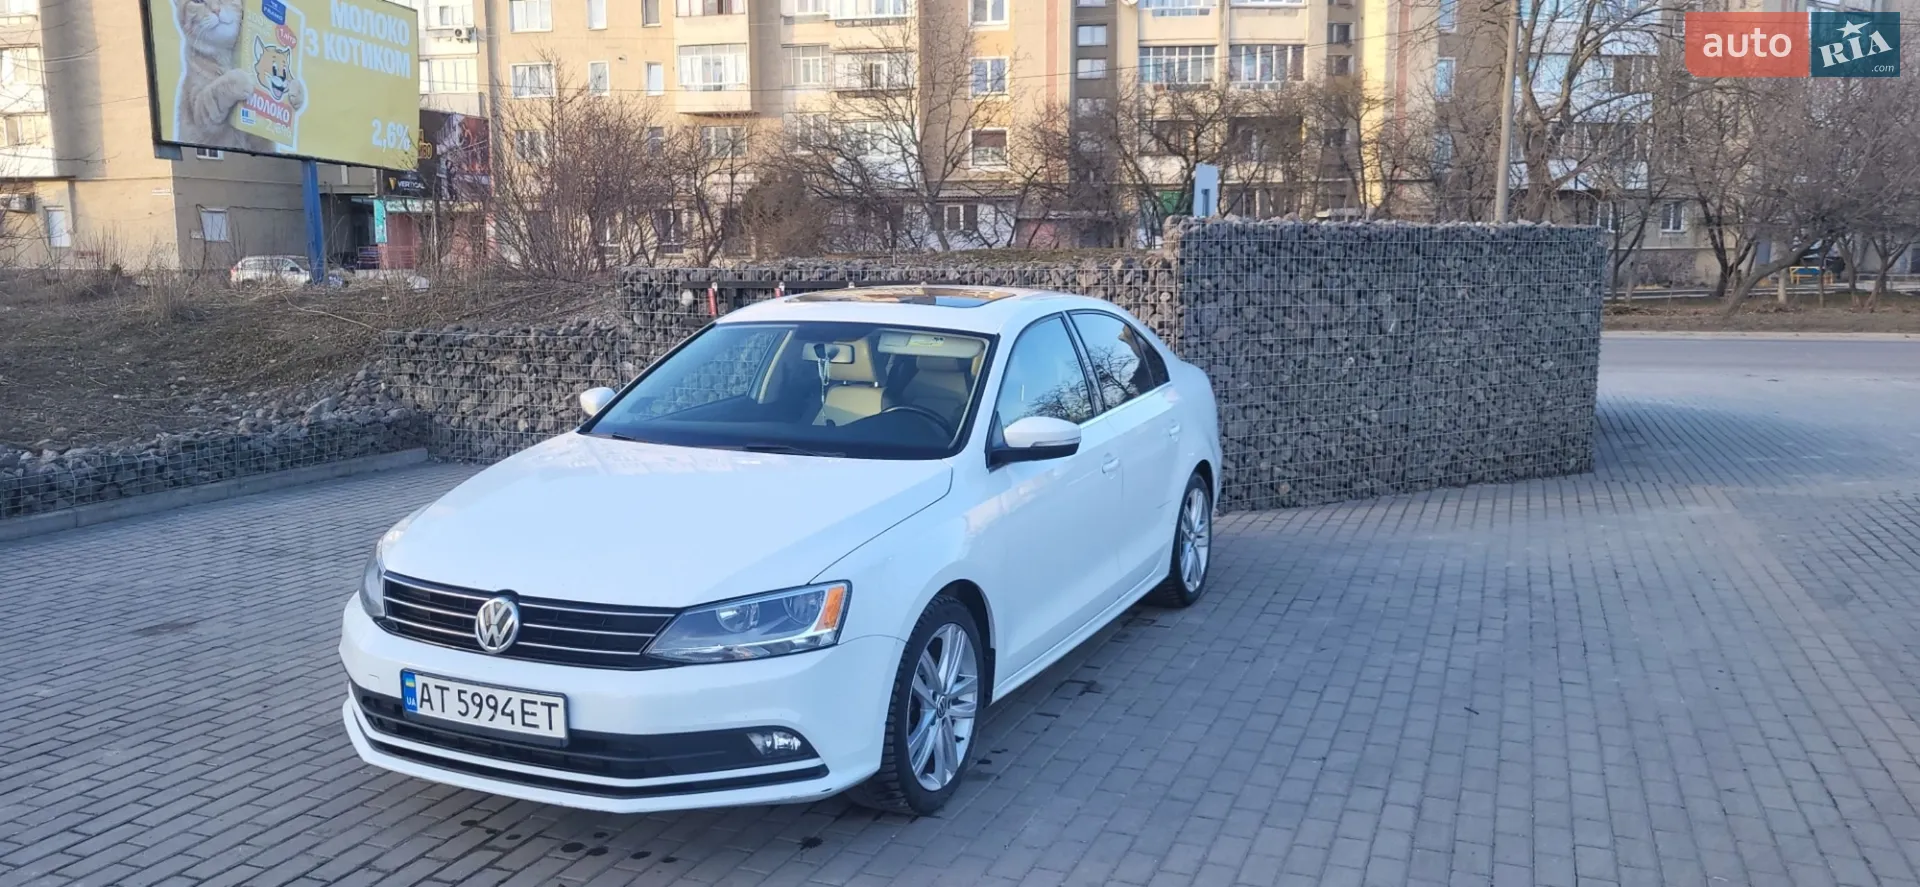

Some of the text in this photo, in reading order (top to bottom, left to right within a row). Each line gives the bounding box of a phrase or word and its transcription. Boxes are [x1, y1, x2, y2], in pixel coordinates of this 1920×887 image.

[330, 0, 410, 47] МОЛОКО
[323, 31, 411, 79] КОТИКОМ
[246, 93, 290, 123] МОЛОКО
[371, 118, 411, 153] 2,6%
[406, 696, 417, 706] UA
